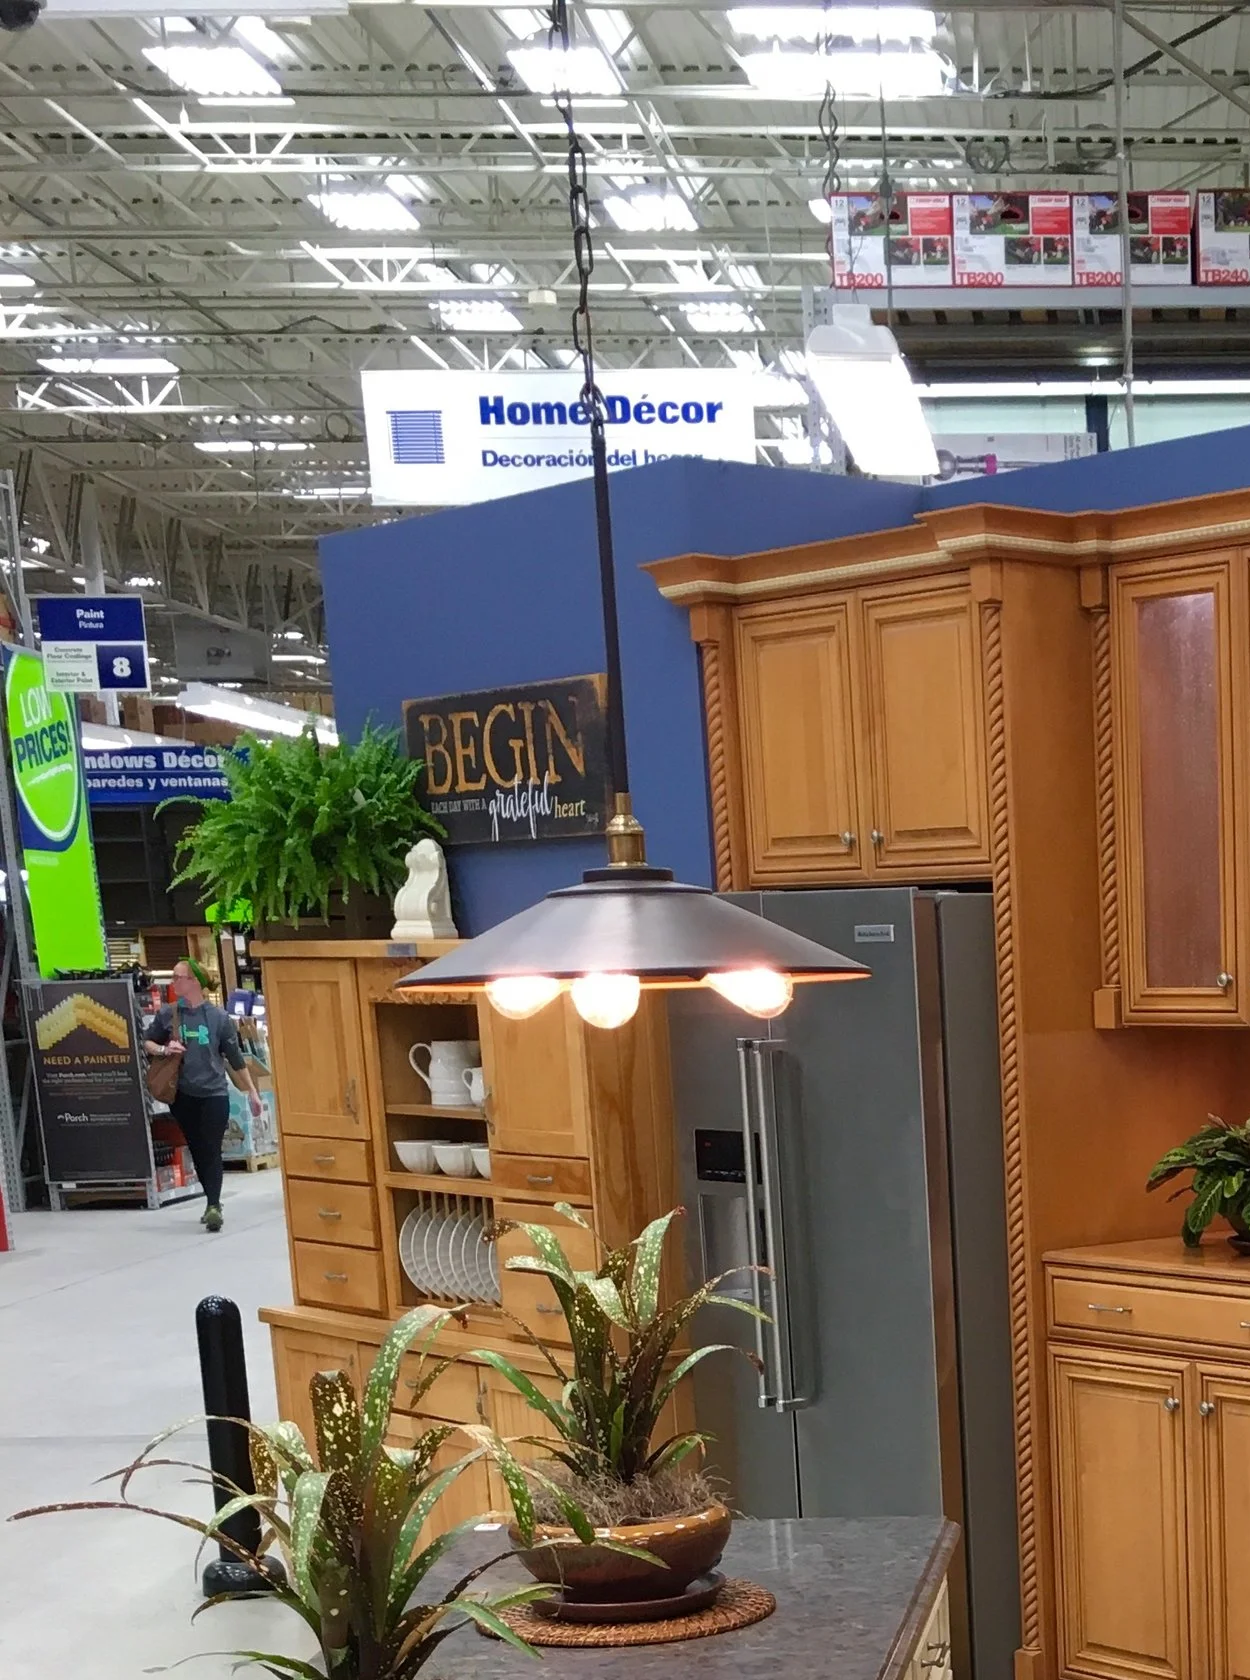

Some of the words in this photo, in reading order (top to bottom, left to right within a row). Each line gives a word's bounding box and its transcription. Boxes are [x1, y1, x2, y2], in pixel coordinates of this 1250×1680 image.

[834, 199, 845, 208] 12
[955, 198, 967, 207] 12
[1076, 198, 1086, 207] 12
[1201, 196, 1212, 204] 12
[836, 272, 884, 286] TB200
[957, 272, 1005, 286] TB200
[1076, 272, 1122, 286] TB200
[1202, 269, 1249, 283] TB240
[479, 395, 591, 425] Home
[605, 393, 723, 425] Décor
[481, 449, 596, 467] Decoración
[607, 449, 637, 467] del
[76, 609, 105, 619] Paint
[78, 621, 104, 629] Pintura
[112, 657, 132, 678] 8
[20, 686, 52, 728] LOW
[14, 720, 73, 773] PRICES!
[418, 700, 586, 795] BEGIN
[85, 752, 157, 769] ndows
[147, 778, 157, 791] y
[160, 776, 229, 788] ventanas
[481, 798, 487, 810] A
[488, 770, 554, 842] grateful
[554, 800, 586, 819] heart
[43, 1056, 71, 1065] NEED
[74, 1056, 82, 1064] A
[64, 1112, 88, 1122] Porch
